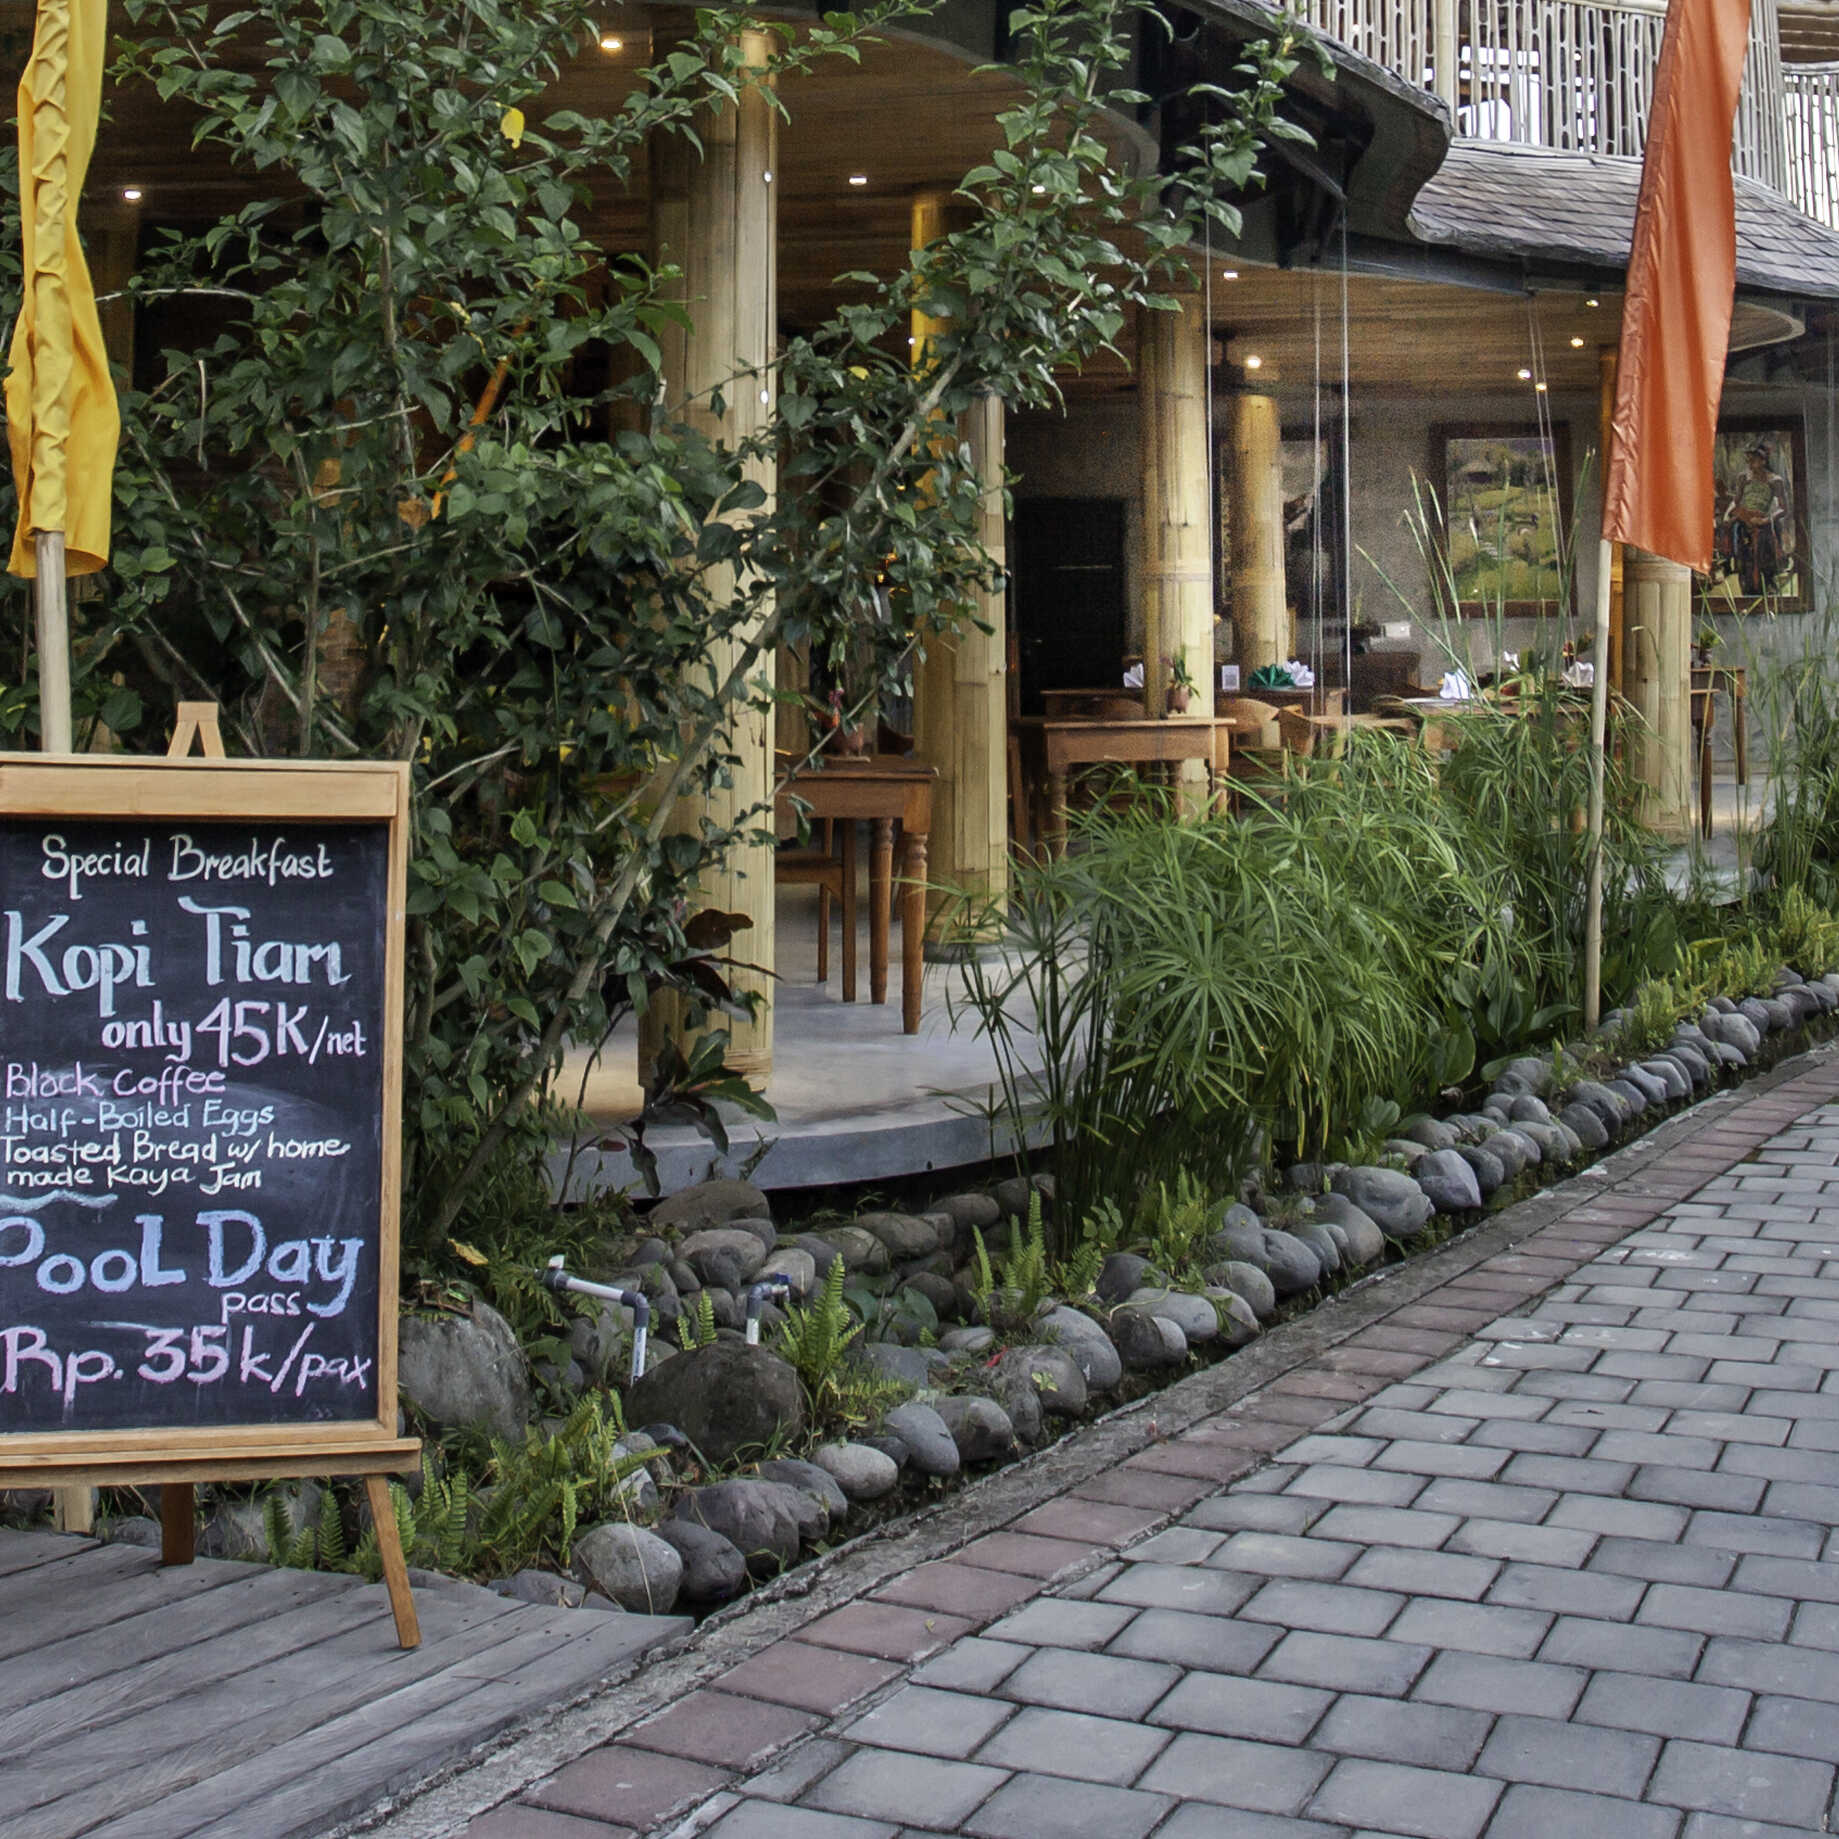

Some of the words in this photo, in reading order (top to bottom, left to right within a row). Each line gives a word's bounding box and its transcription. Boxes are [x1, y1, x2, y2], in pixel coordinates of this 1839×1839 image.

[41, 833, 151, 900] Special
[167, 834, 335, 887] Breakfast
[3, 910, 156, 1018] Kopi
[177, 896, 352, 986] Tiam
[101, 999, 191, 1063] only
[5, 1062, 104, 1099] Black
[112, 1066, 227, 1106] Coffee
[5, 1101, 189, 1136] Half-Boiled
[202, 1099, 275, 1136] Eggs
[0, 1132, 121, 1165] Toasted
[133, 1131, 218, 1163] Bread
[227, 1139, 261, 1163] w/
[267, 1131, 352, 1160] home
[6, 1166, 94, 1188] made
[199, 1162, 262, 1195] Jam
[195, 1209, 364, 1318] Day
[221, 1290, 302, 1324] pass
